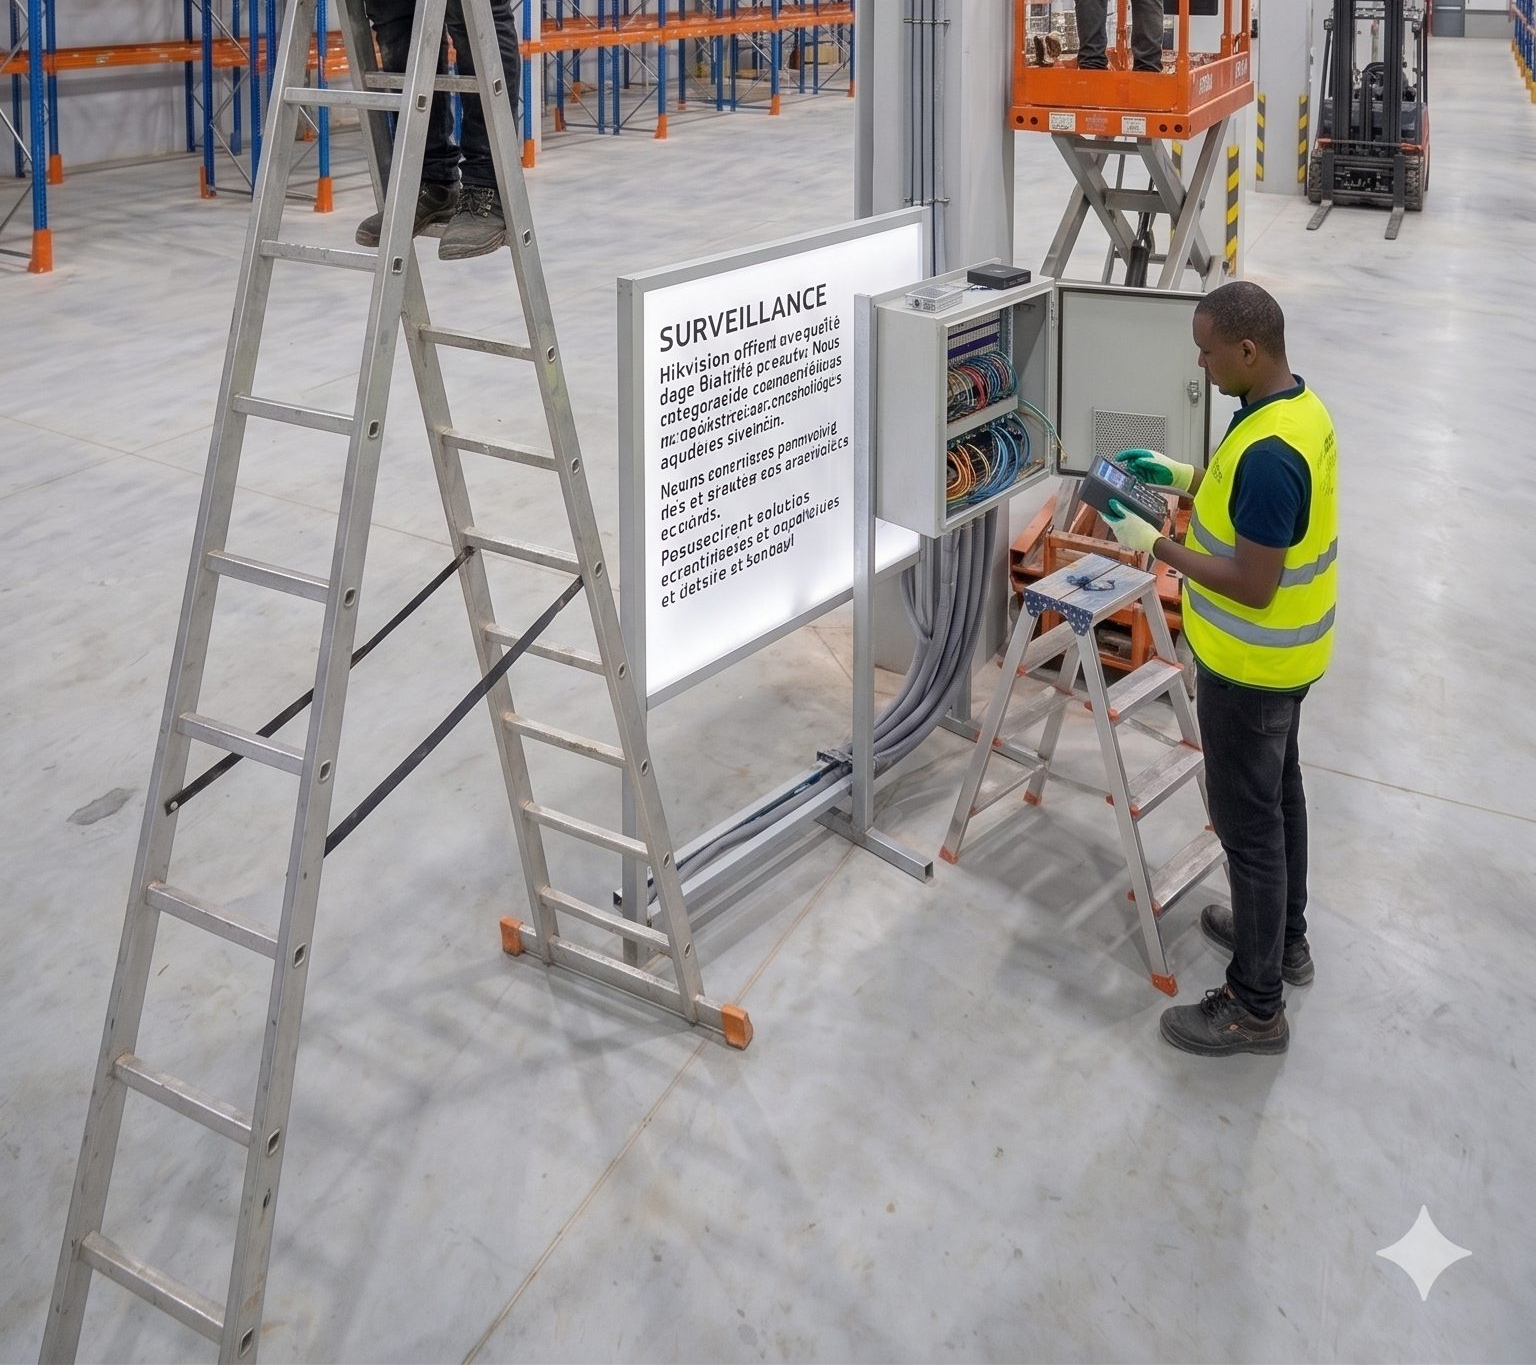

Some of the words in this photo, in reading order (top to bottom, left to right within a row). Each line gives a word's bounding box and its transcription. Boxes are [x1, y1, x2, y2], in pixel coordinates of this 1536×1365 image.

[660, 283, 827, 352] SURVEILLANCE
[660, 353, 730, 384] Hikvision
[660, 385, 695, 405] dage
[812, 337, 840, 356] Nous
[690, 491, 704, 509] et
[756, 526, 770, 544] et
[661, 590, 676, 608] et
[730, 558, 744, 576] et
